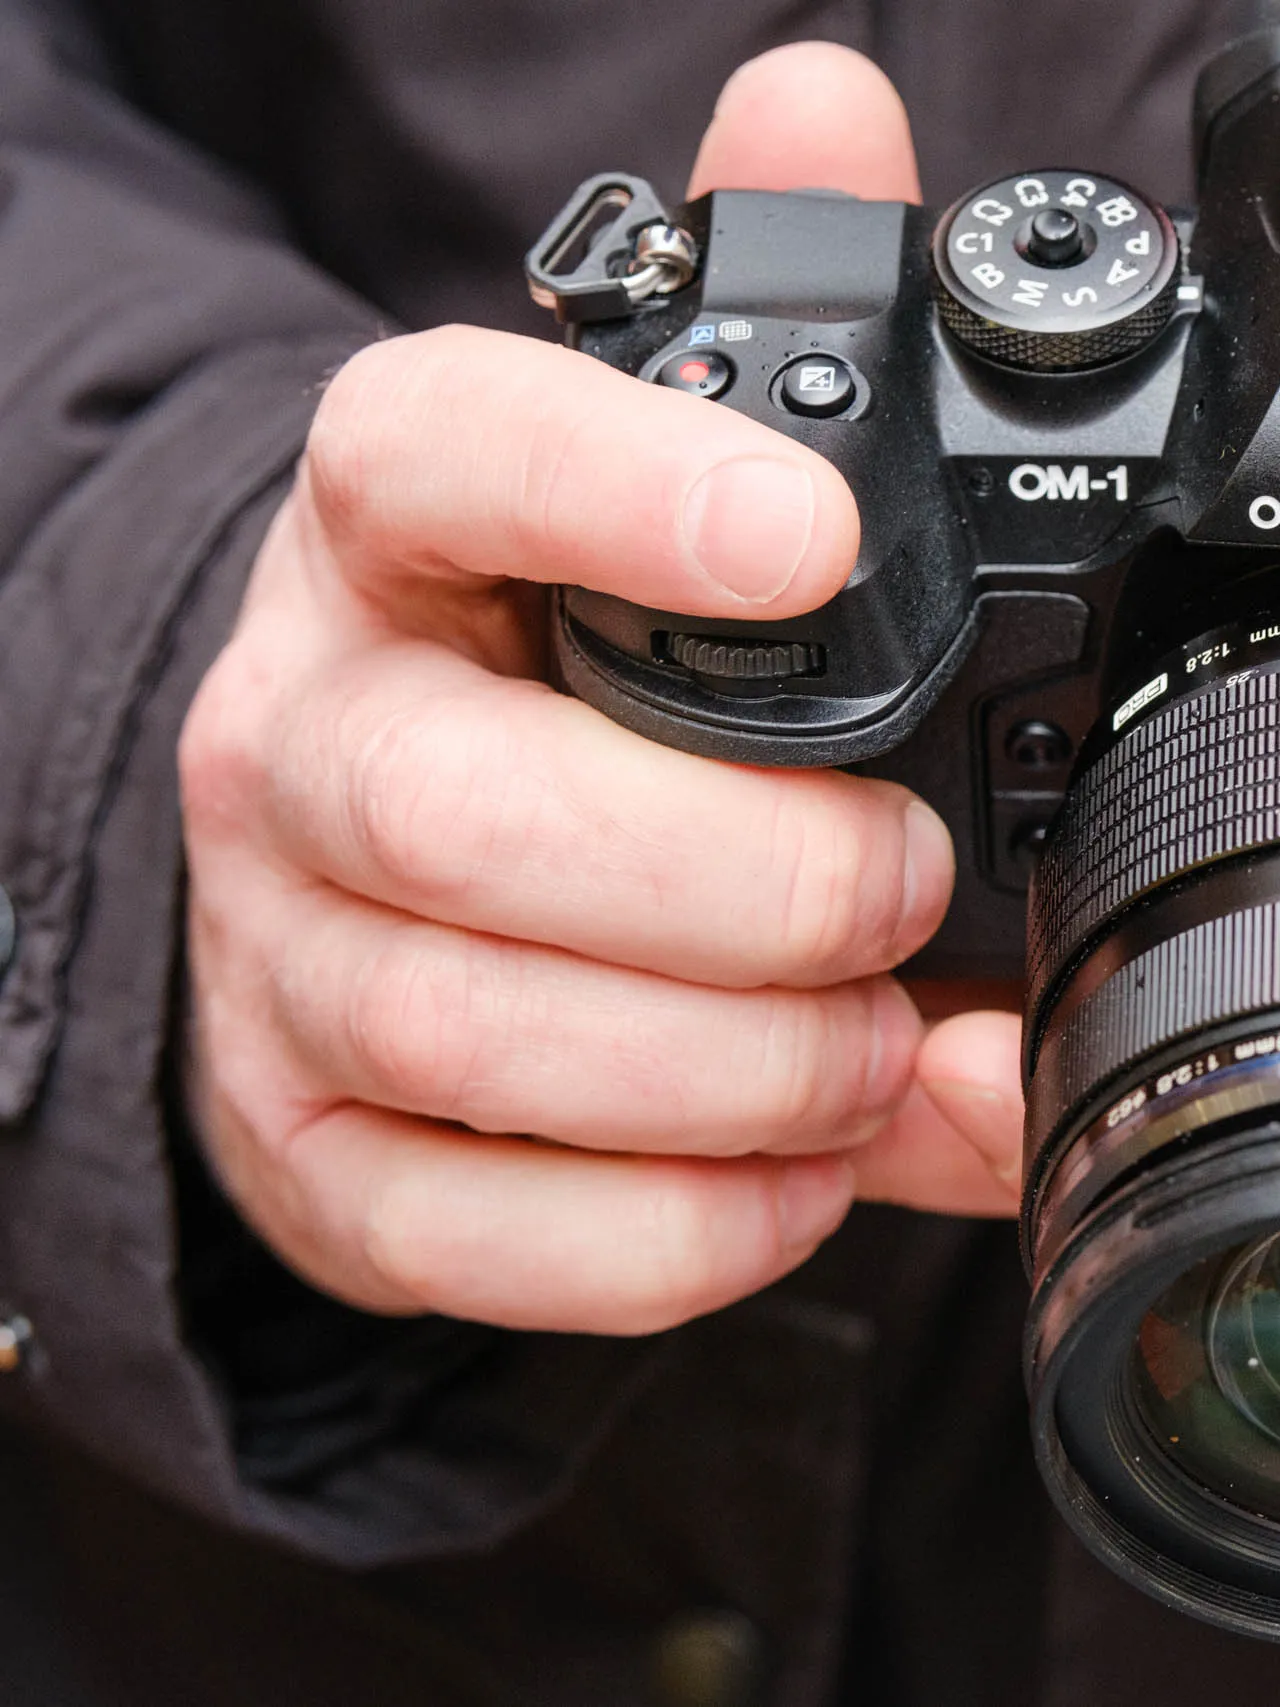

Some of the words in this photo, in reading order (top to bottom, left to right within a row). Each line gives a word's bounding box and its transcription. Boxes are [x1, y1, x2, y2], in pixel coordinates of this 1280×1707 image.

[1014, 178, 1050, 208] C3
[1059, 178, 1097, 209] C4
[972, 199, 1014, 226] C2
[955, 232, 994, 254] C1
[1125, 230, 1151, 257] P
[970, 262, 1005, 289] B
[1105, 259, 1140, 287] A
[1012, 279, 1049, 308] M
[1062, 287, 1098, 308] S
[1008, 462, 1128, 502] OM-1
[1185, 642, 1231, 674] 1:2.8
[1114, 674, 1167, 730] PRO
